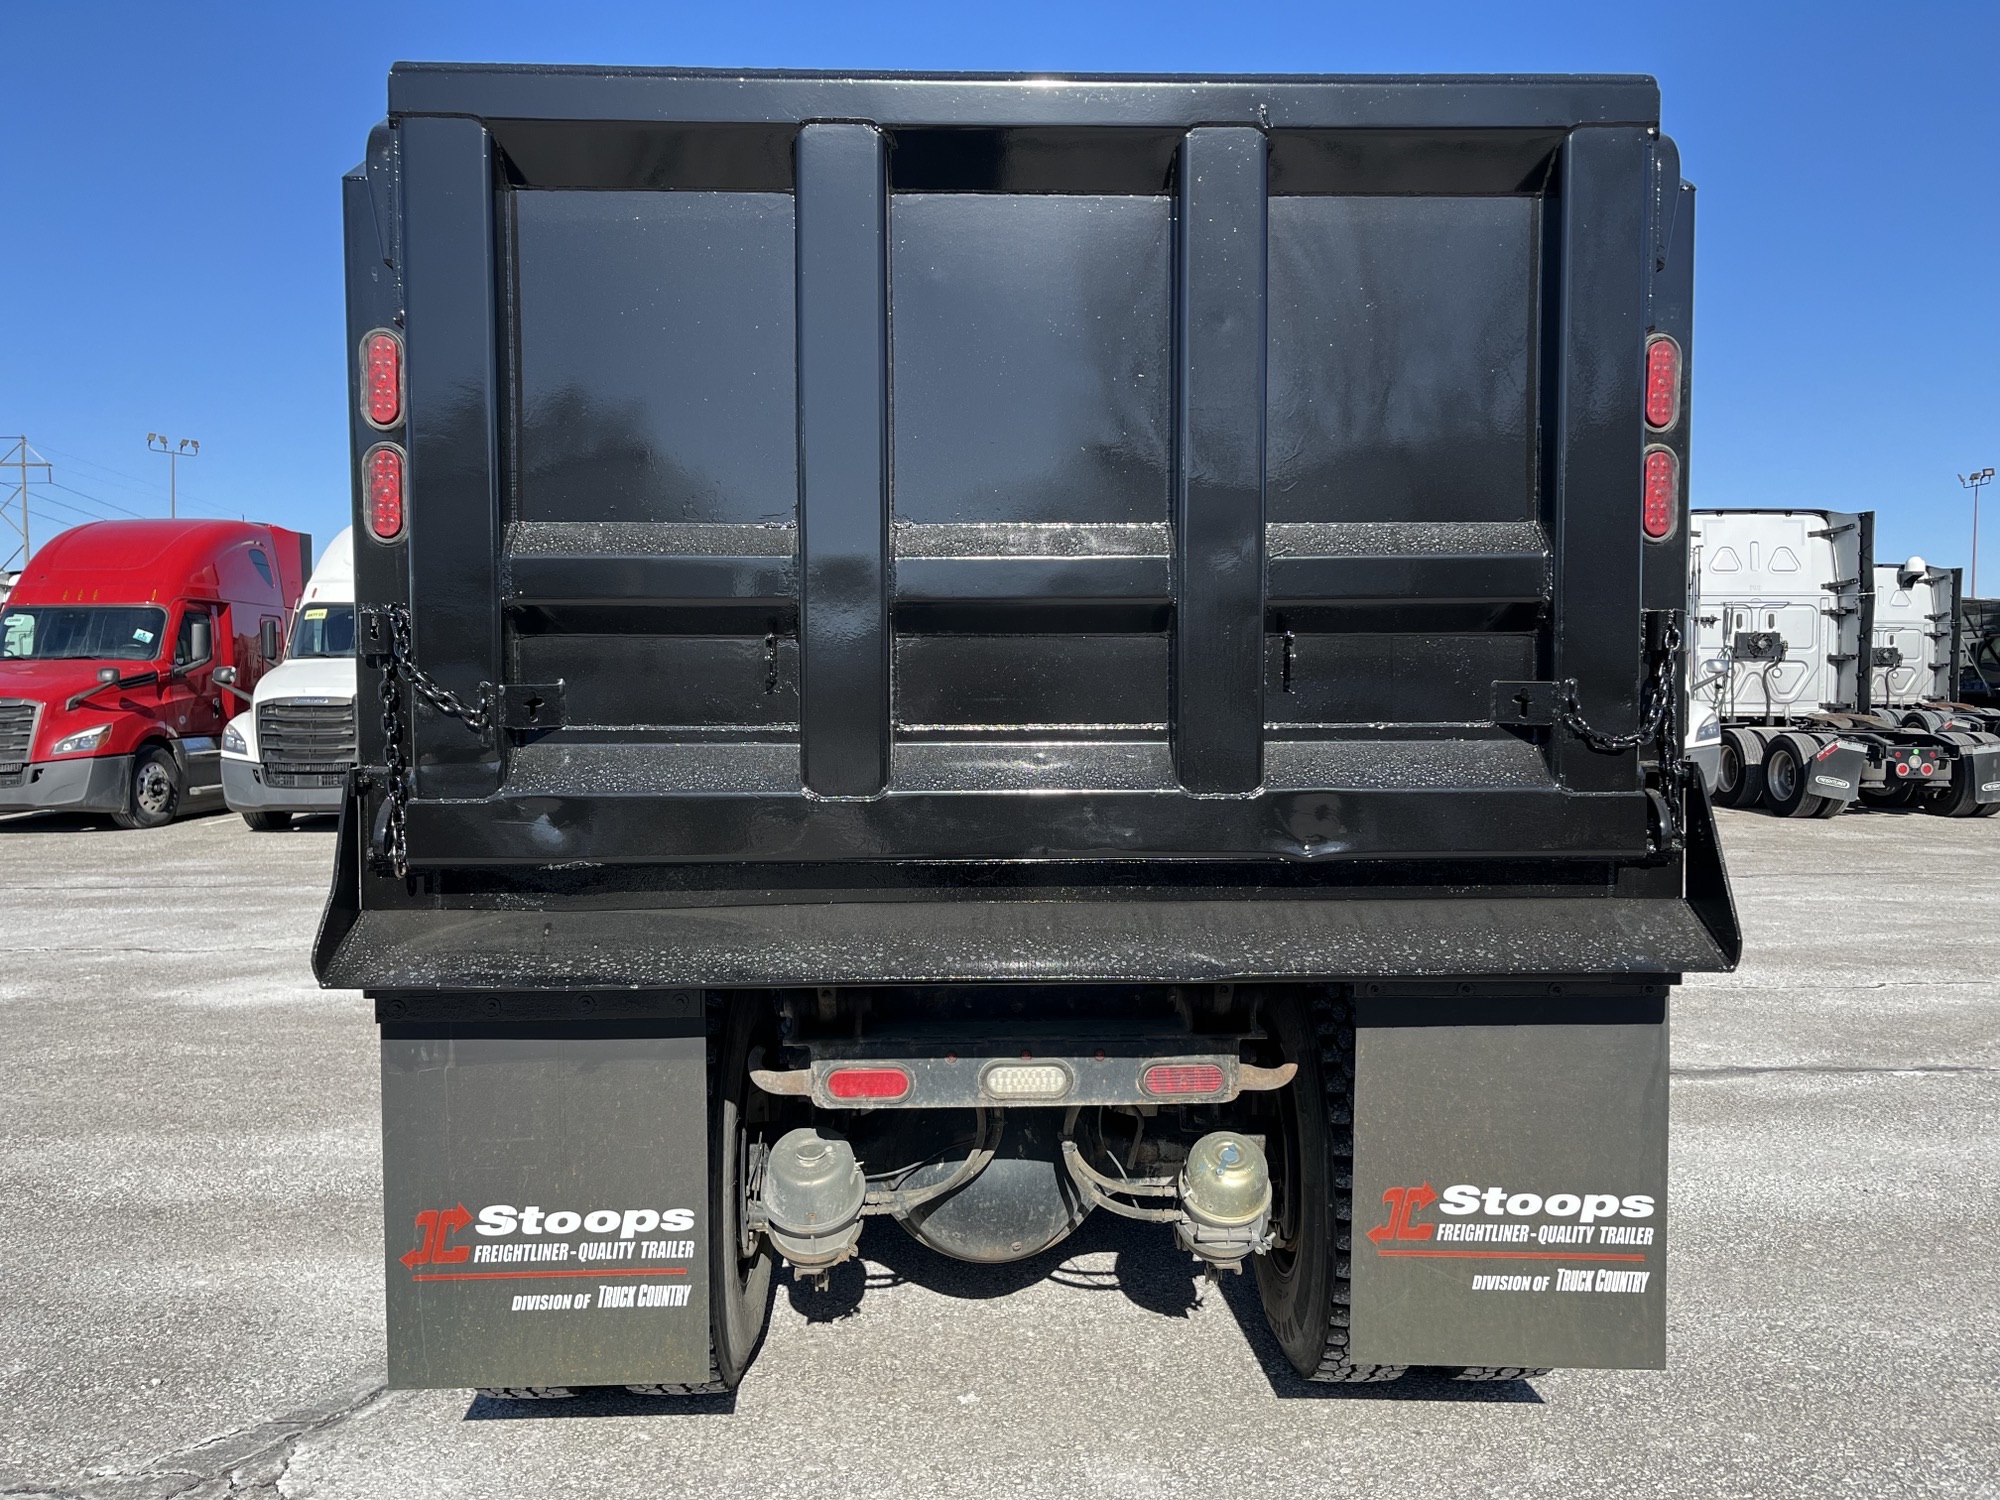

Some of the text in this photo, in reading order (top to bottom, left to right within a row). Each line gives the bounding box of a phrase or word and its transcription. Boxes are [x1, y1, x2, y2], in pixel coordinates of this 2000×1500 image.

[1438, 1184, 1656, 1223] Stoops
[475, 1204, 695, 1239] Stoops
[1599, 1225, 1655, 1246] TRAILER
[640, 1240, 695, 1260] TRAILER
[1471, 1268, 1650, 1294] DIVISION OF TRUCK COUNTRY
[511, 1283, 693, 1312] DIVISION OF TRUCK COUNTRY
